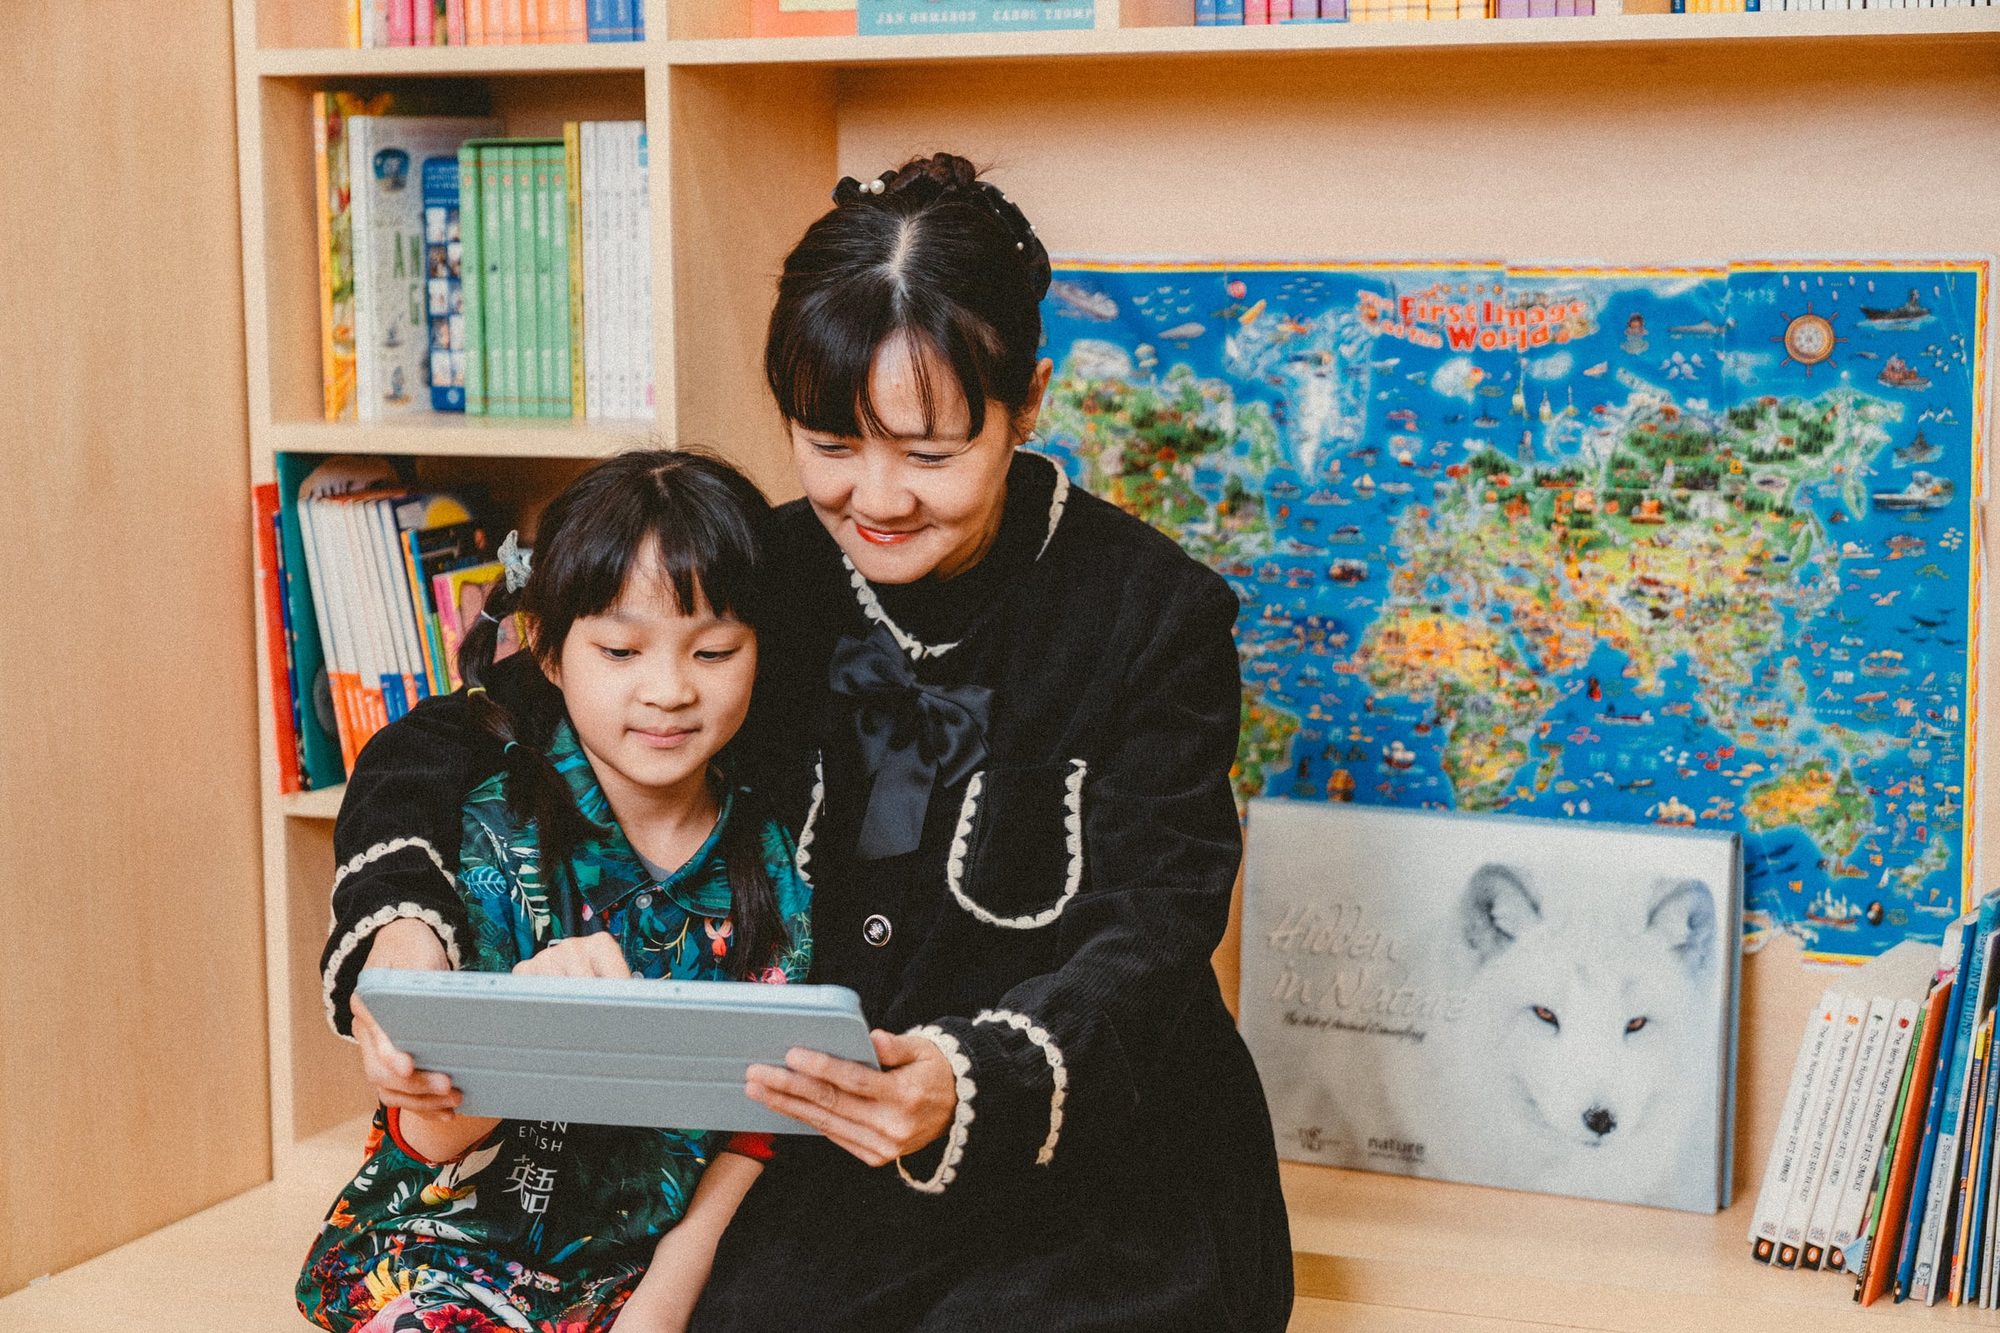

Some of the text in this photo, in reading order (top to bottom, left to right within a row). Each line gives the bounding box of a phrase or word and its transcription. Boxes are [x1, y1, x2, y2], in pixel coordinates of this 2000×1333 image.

[1400, 297, 1477, 325] First
[1483, 300, 1587, 328] Image
[1447, 325, 1550, 352] World
[1960, 966, 1982, 1037] INVENTIONS
